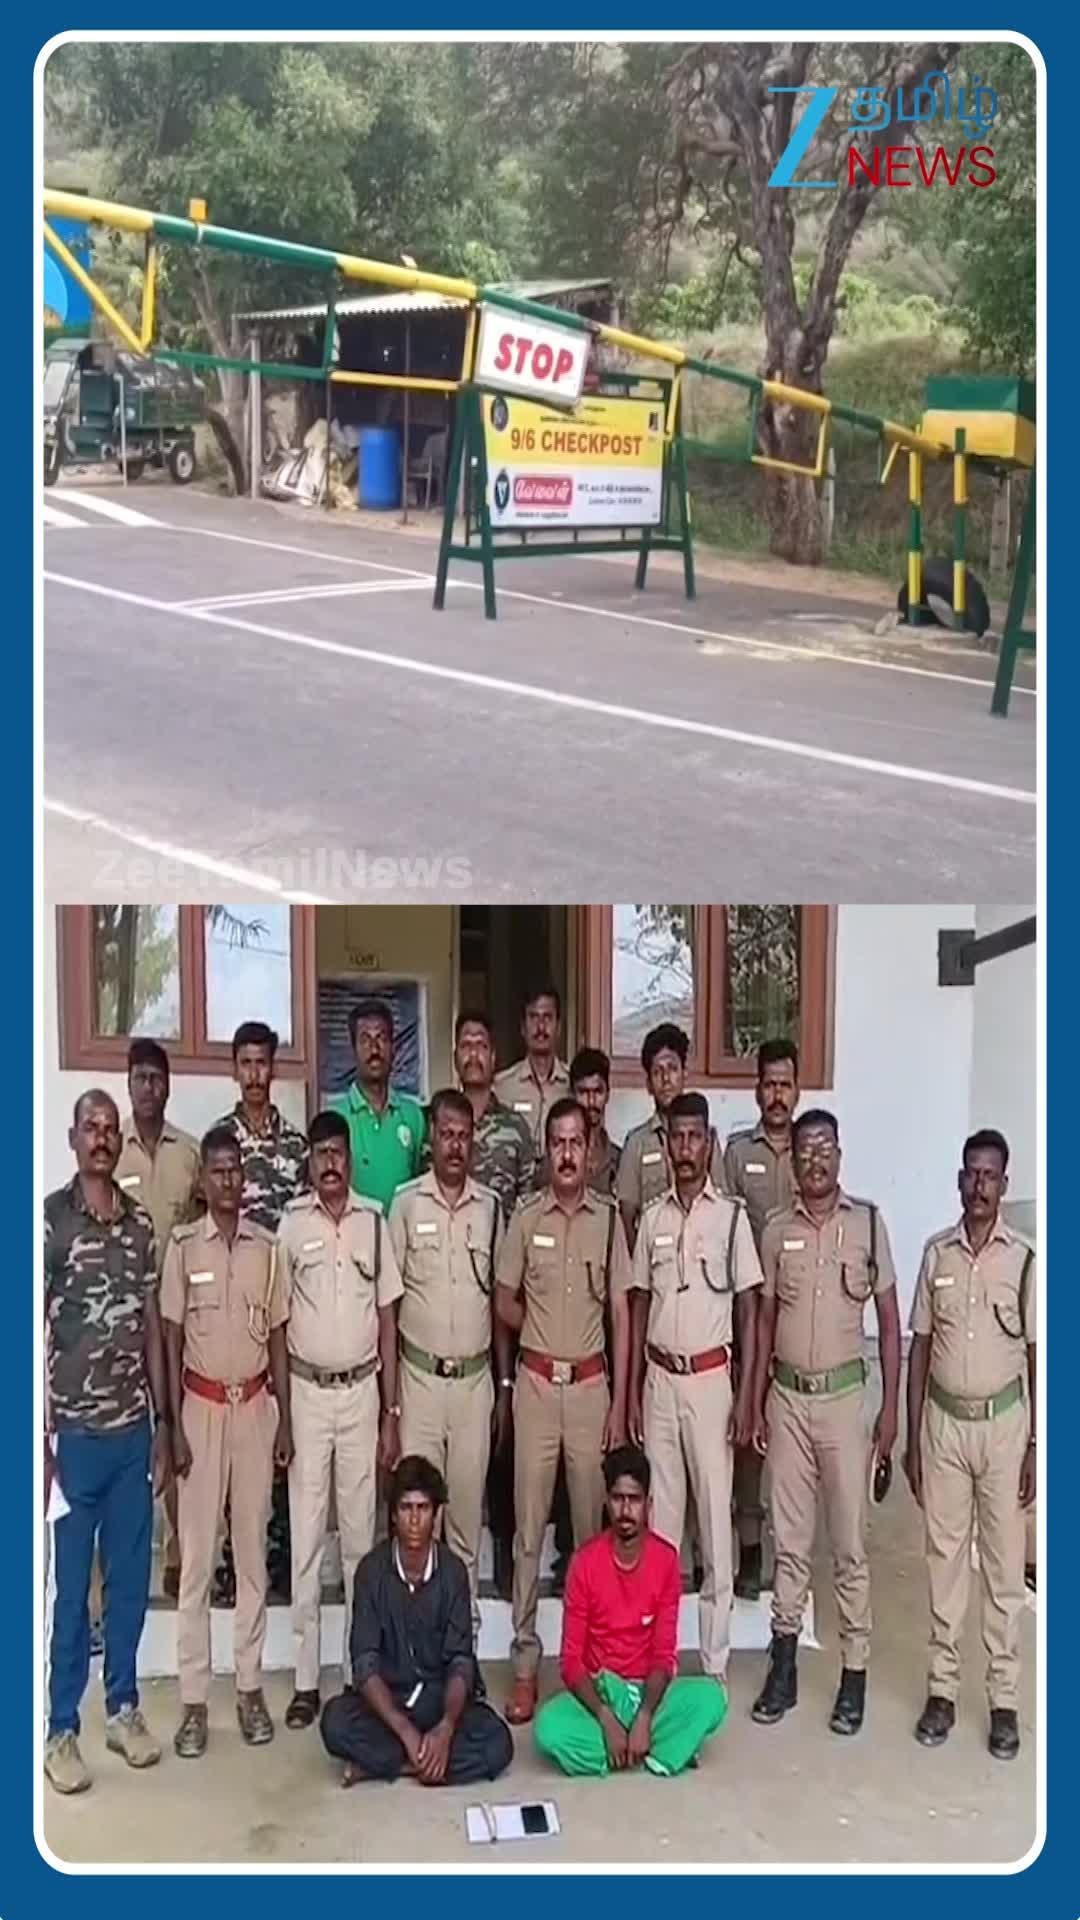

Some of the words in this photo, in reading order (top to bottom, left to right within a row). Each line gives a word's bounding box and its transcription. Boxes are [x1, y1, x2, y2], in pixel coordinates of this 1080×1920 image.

[494, 333, 574, 383] STOP
[511, 428, 536, 451] 9/6
[541, 431, 643, 456] CHECKPOST
